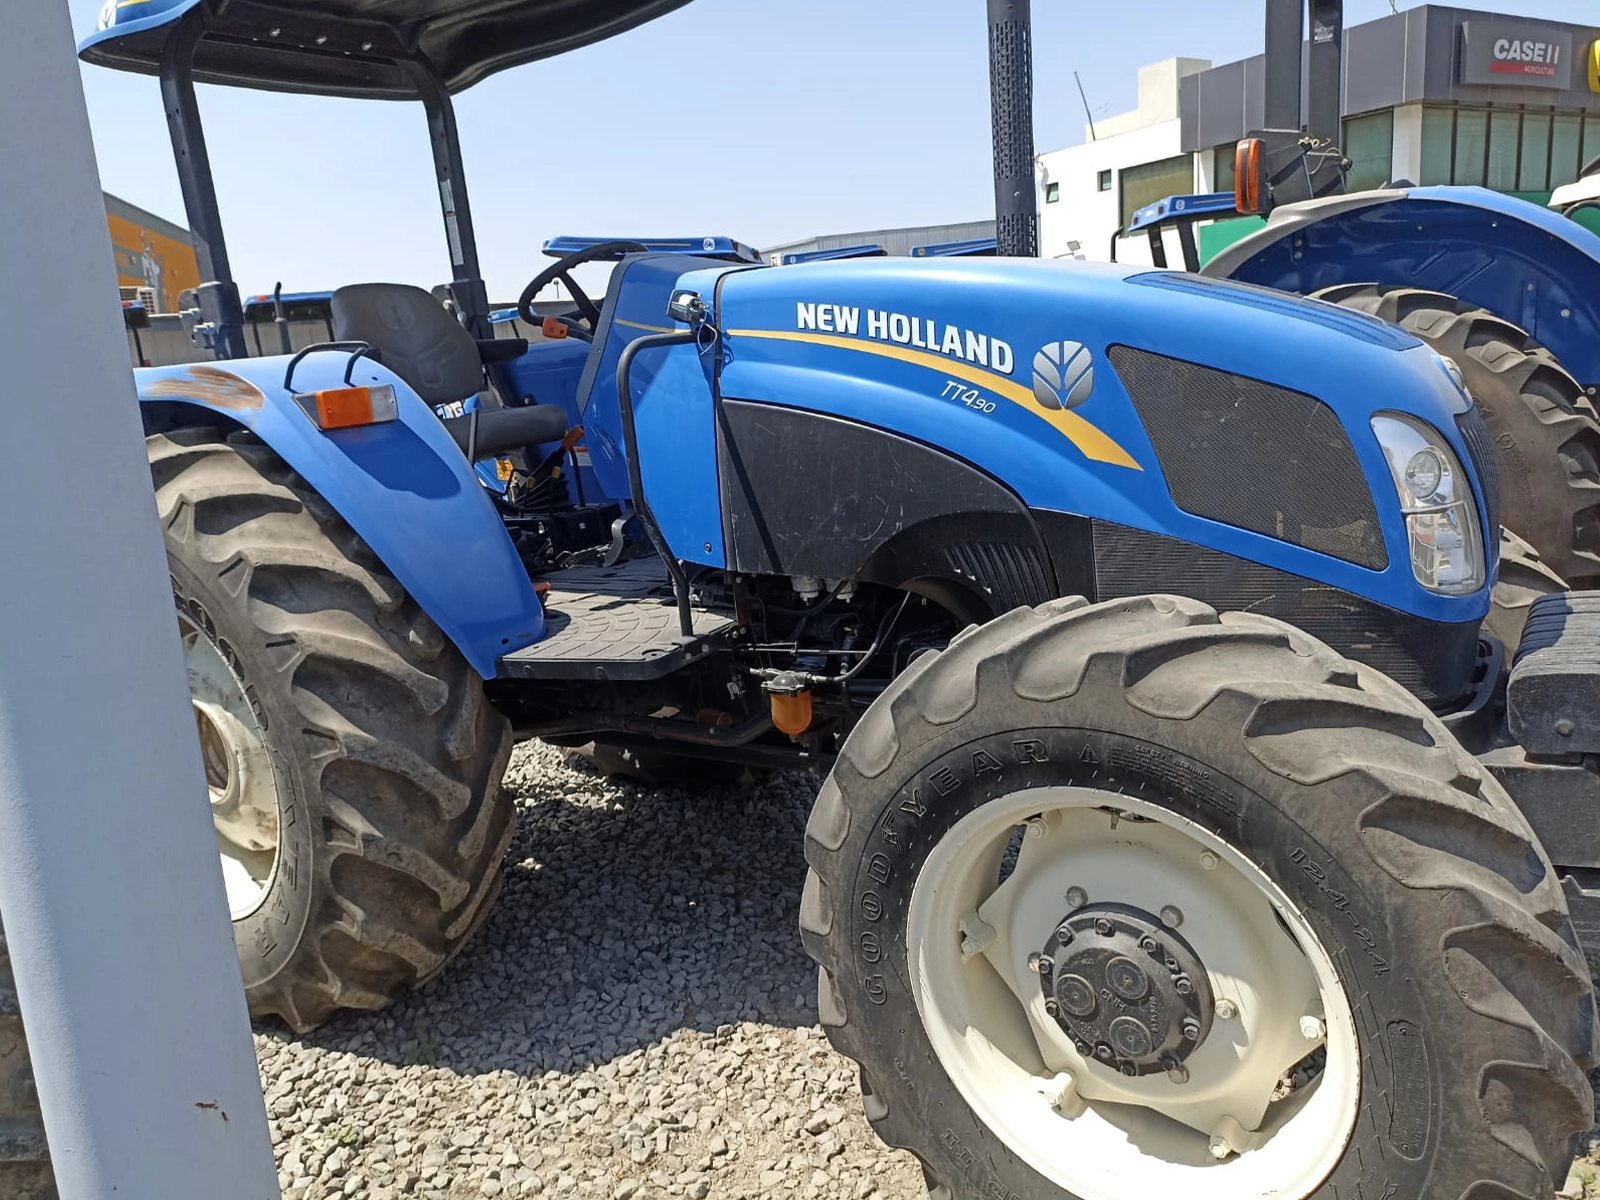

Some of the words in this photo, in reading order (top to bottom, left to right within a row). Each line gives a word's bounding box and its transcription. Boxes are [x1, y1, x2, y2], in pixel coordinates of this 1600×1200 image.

[1493, 38, 1546, 63] CASE
[796, 302, 860, 335] NEW
[867, 309, 1015, 375] HOLLAND
[861, 738, 1049, 1005] GOODYEAR
